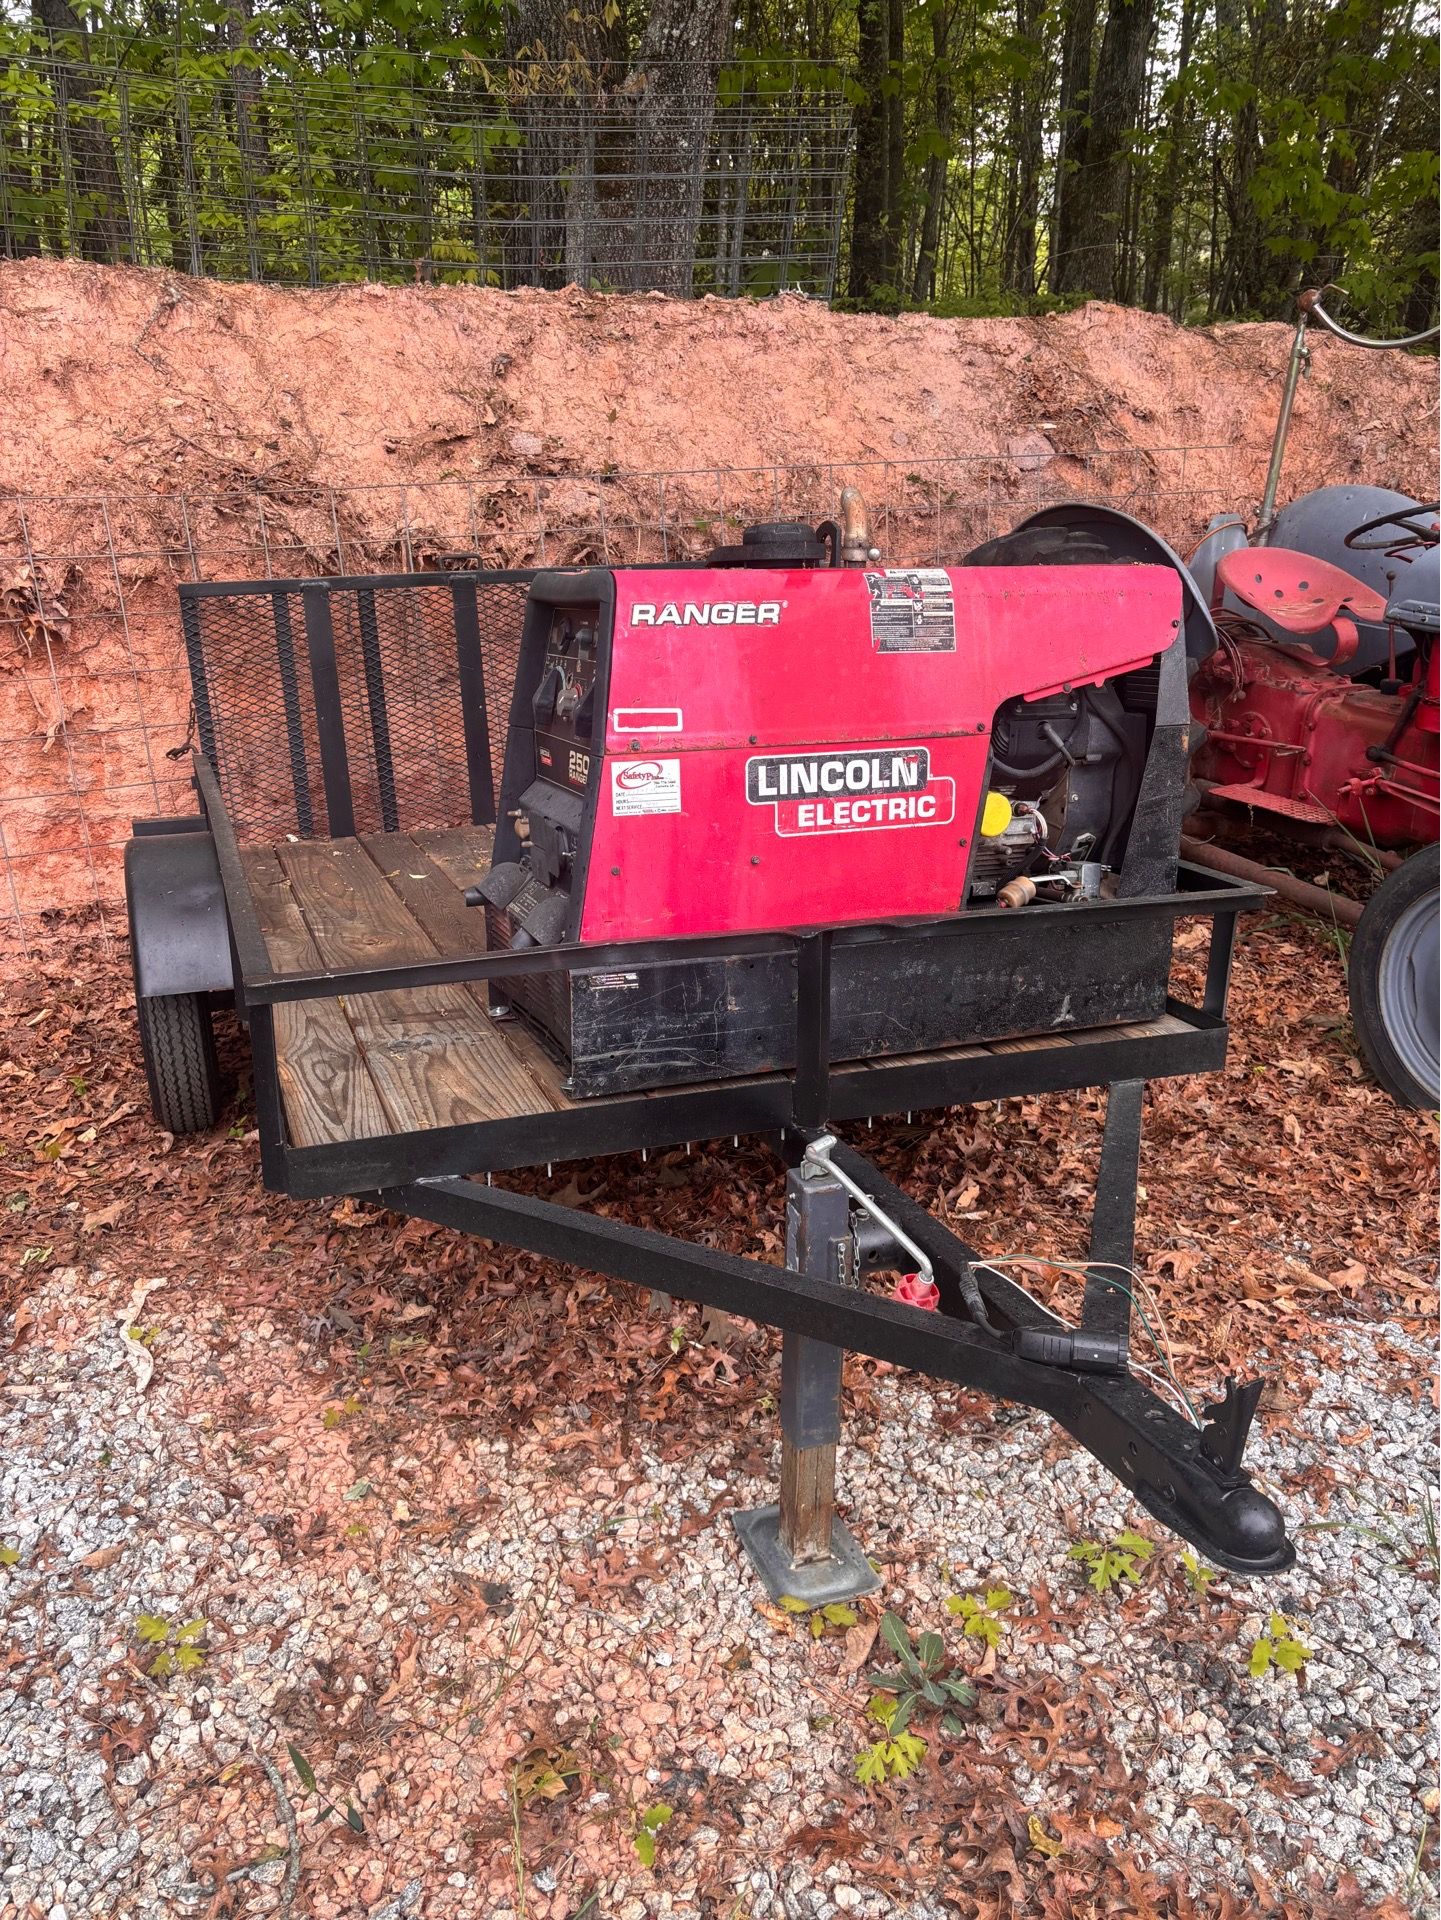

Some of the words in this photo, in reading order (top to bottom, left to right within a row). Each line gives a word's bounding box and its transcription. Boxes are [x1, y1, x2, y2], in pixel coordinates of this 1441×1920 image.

[630, 602, 782, 627] RANGER
[569, 750, 590, 775] 250
[757, 756, 919, 797] LINCOLN
[797, 795, 937, 828] ELECTRIC
